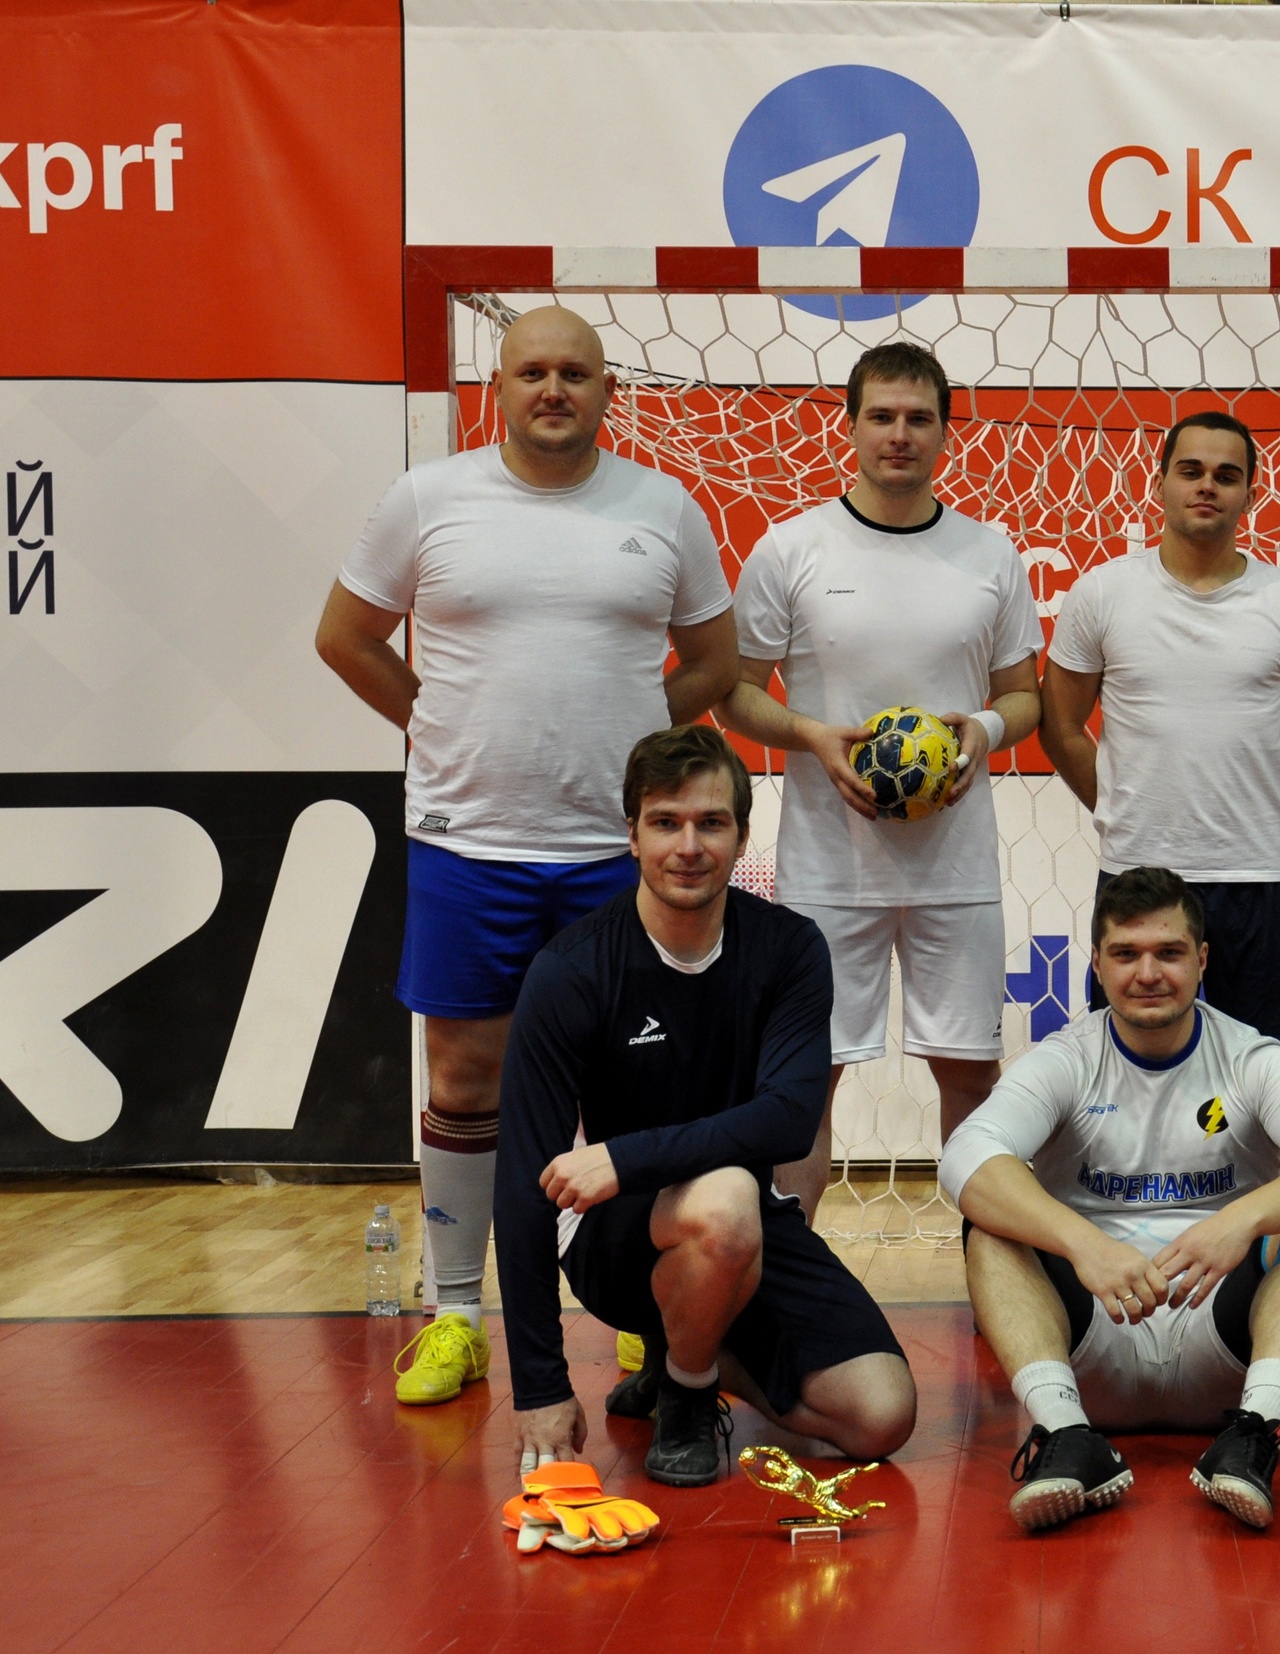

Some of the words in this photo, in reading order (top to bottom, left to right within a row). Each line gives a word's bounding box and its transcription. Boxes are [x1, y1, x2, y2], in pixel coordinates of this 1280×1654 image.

[1088, 145, 1253, 245] СК
[628, 1033, 667, 1045] DEMIX
[1078, 1162, 1237, 1203] АДРЕНАЛИН
